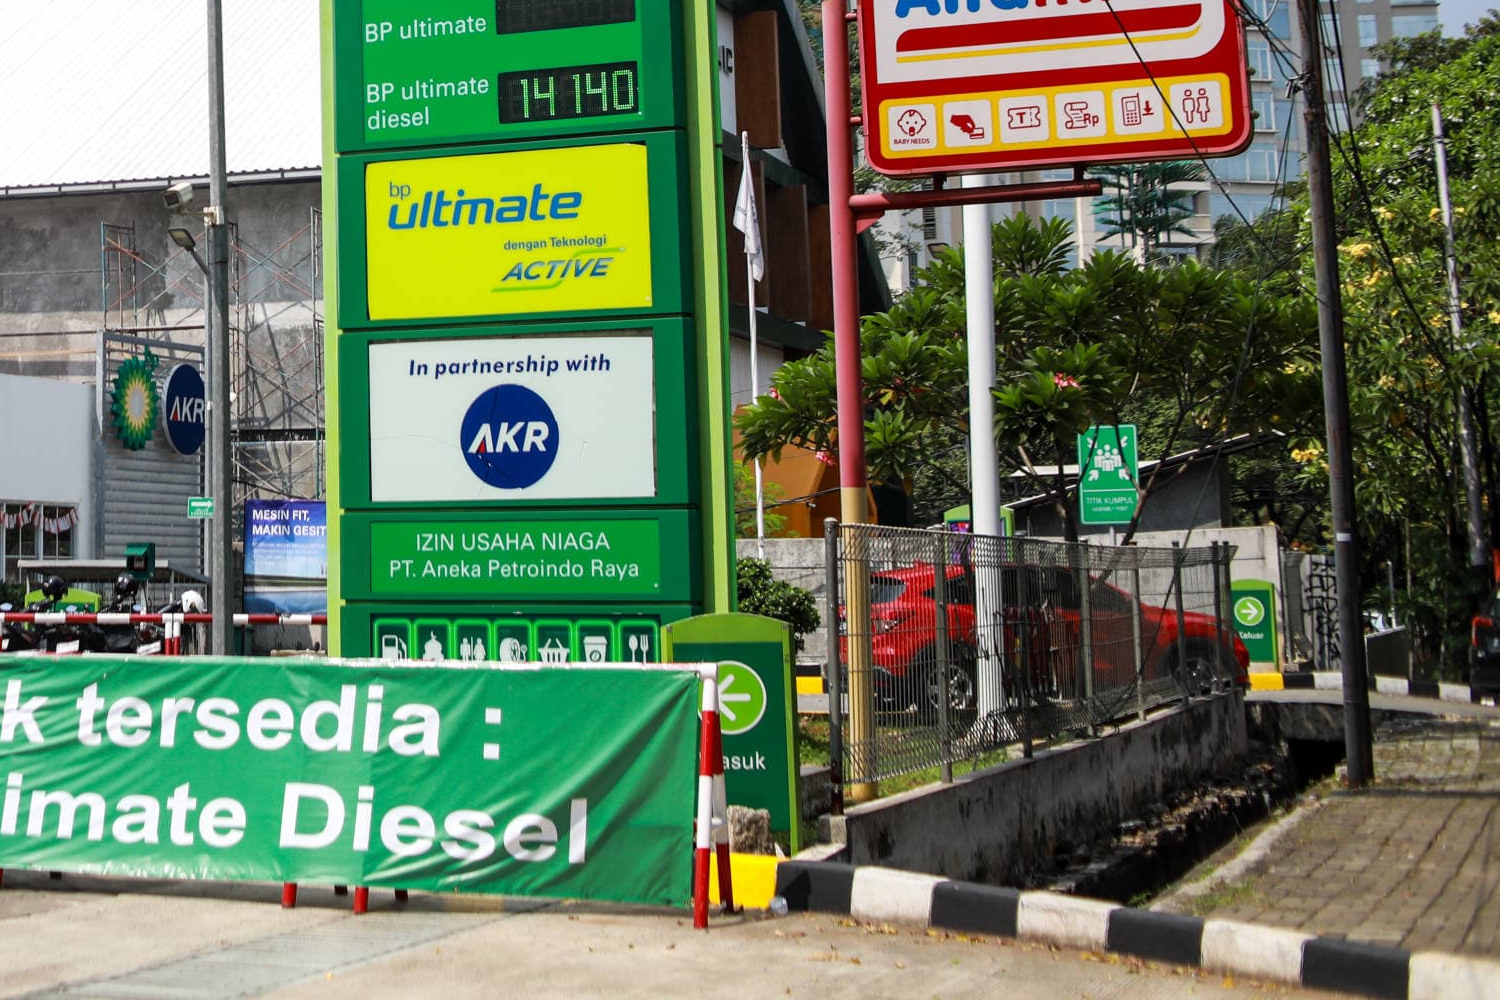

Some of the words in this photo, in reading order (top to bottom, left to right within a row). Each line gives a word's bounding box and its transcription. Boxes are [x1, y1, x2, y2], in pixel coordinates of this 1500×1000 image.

[364, 22, 393, 43] BP
[400, 15, 487, 40] ultimate
[366, 83, 394, 104] BP
[401, 77, 490, 100] ultimate
[367, 107, 430, 130] diesel
[389, 181, 411, 199] bp
[388, 183, 582, 231] ultimate
[503, 238, 548, 252] dengan
[549, 234, 607, 249] Teknologi
[501, 257, 614, 282] ACTIVE
[409, 359, 429, 377] In
[434, 354, 560, 380] partnership
[566, 353, 611, 373] with
[169, 395, 205, 423] AKR
[467, 421, 550, 454] AKR
[252, 509, 290, 521] MESIN
[292, 510, 310, 522] FIT,
[252, 524, 291, 536] MAKIN
[293, 525, 326, 536] GESIT
[416, 533, 454, 552] IZIN
[461, 533, 536, 552] USAHA
[542, 531, 611, 551] NIAGA
[390, 559, 416, 578] PT.
[422, 559, 481, 578] Aneka
[488, 558, 584, 578] Petroindo
[591, 558, 639, 582] Raya
[75, 681, 441, 758] tersedia
[699, 751, 767, 770] asuk
[279, 781, 588, 865] Diesel
